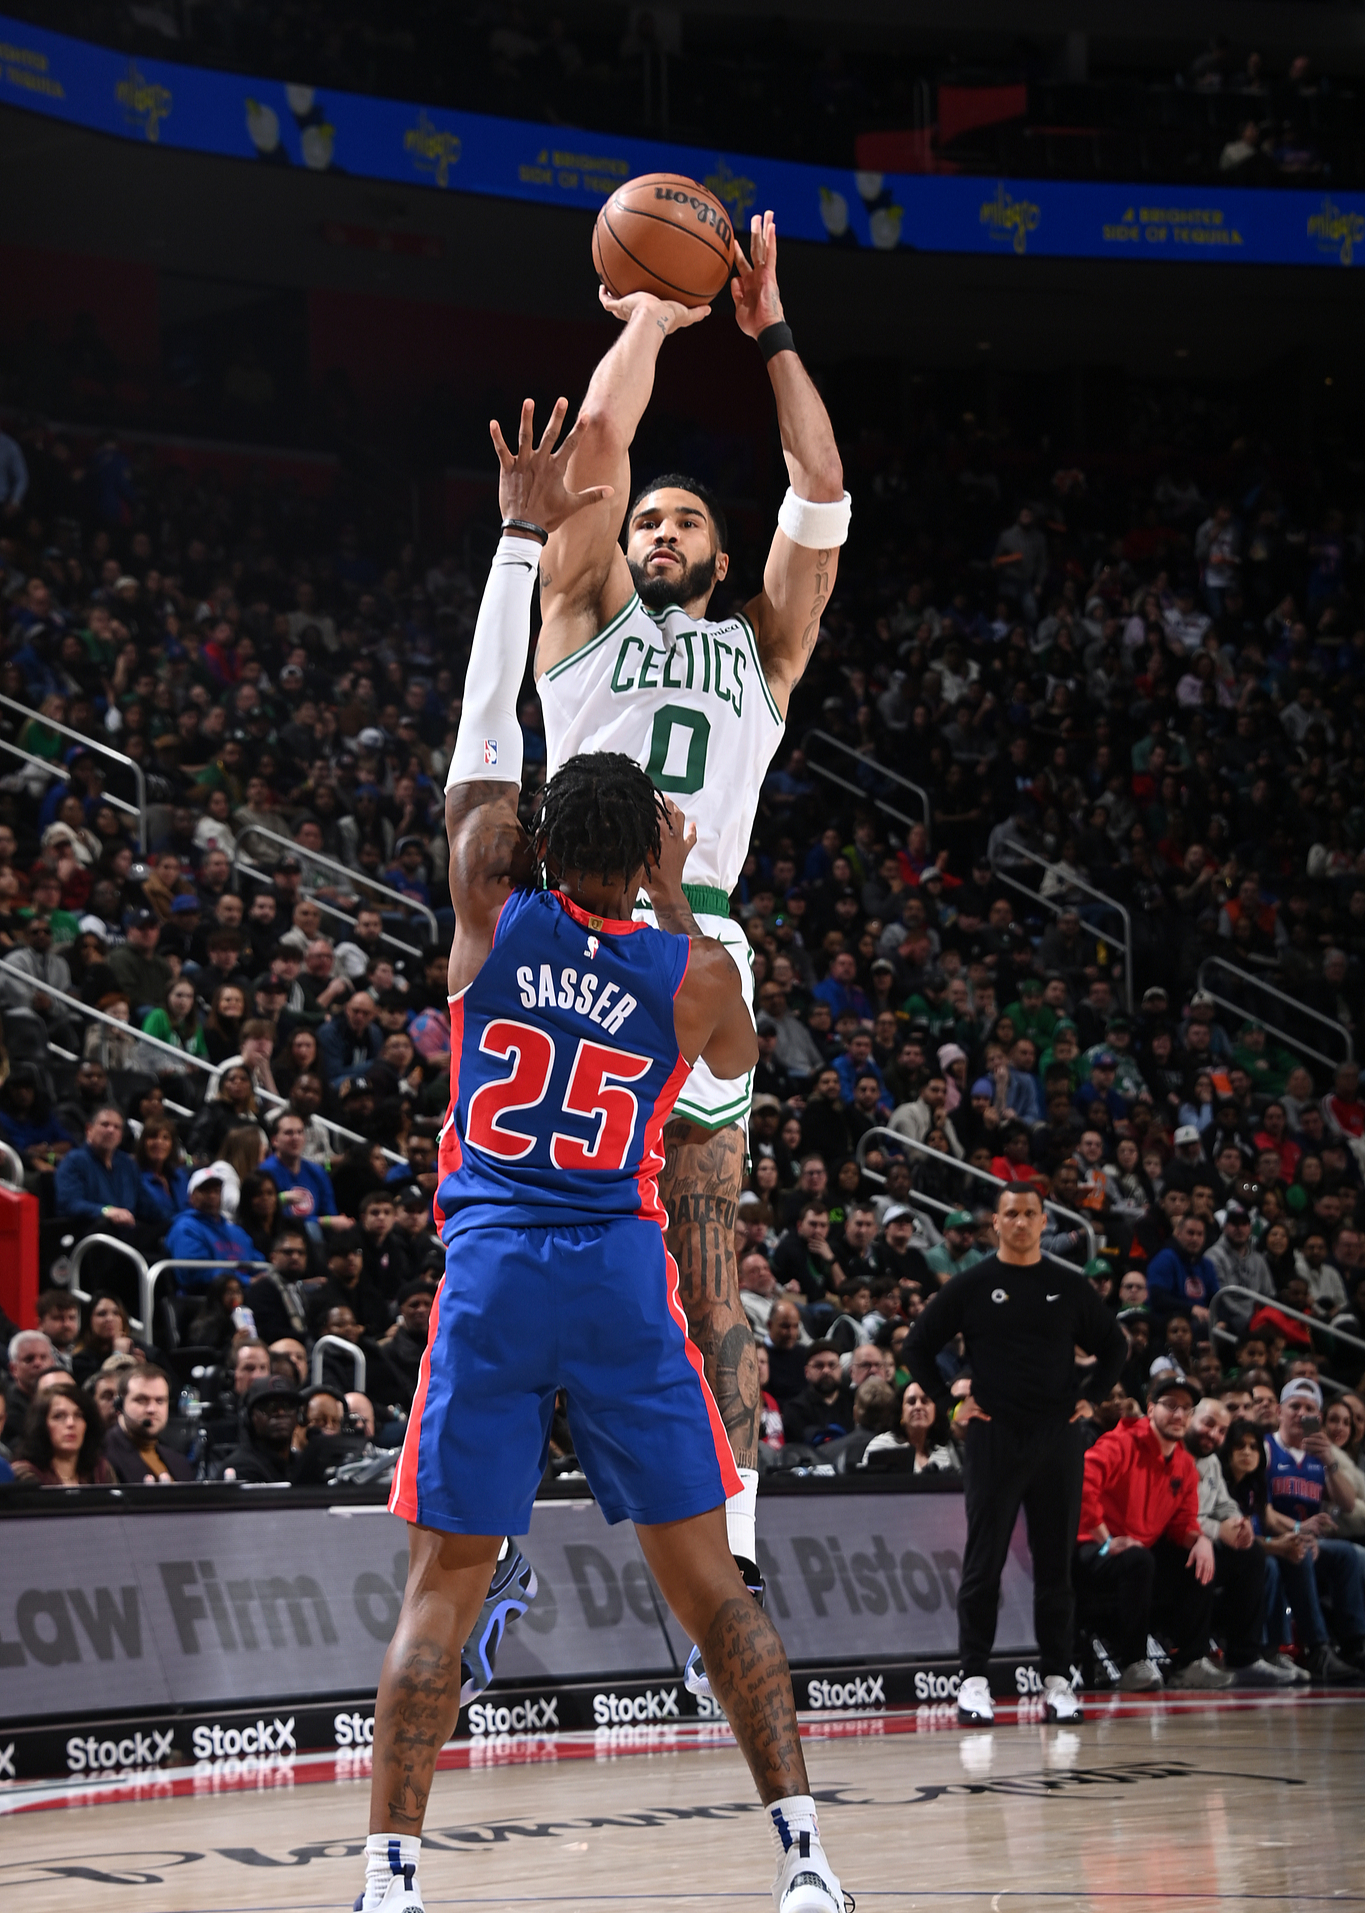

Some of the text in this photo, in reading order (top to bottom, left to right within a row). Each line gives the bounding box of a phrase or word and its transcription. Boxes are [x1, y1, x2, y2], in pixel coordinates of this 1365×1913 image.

[654, 187, 732, 251] Wilson
[1102, 224, 1139, 242] SIDE
[1145, 226, 1168, 242] OF
[710, 623, 740, 637] mica
[610, 630, 747, 719] CELTICS
[645, 703, 712, 795] 0
[516, 963, 638, 1036] SASSER
[464, 1018, 654, 1170] 25
[158, 1559, 340, 1656] Firm
[353, 1549, 410, 1643] o
[790, 1535, 964, 1618] Piston
[592, 1687, 680, 1724] StockX
[807, 1674, 885, 1709] StockX
[914, 1669, 964, 1700] Stoc
[333, 1712, 376, 1746] Sto
[467, 1697, 560, 1735] StockX
[66, 1728, 175, 1771] StockX
[192, 1716, 297, 1760] StockX
